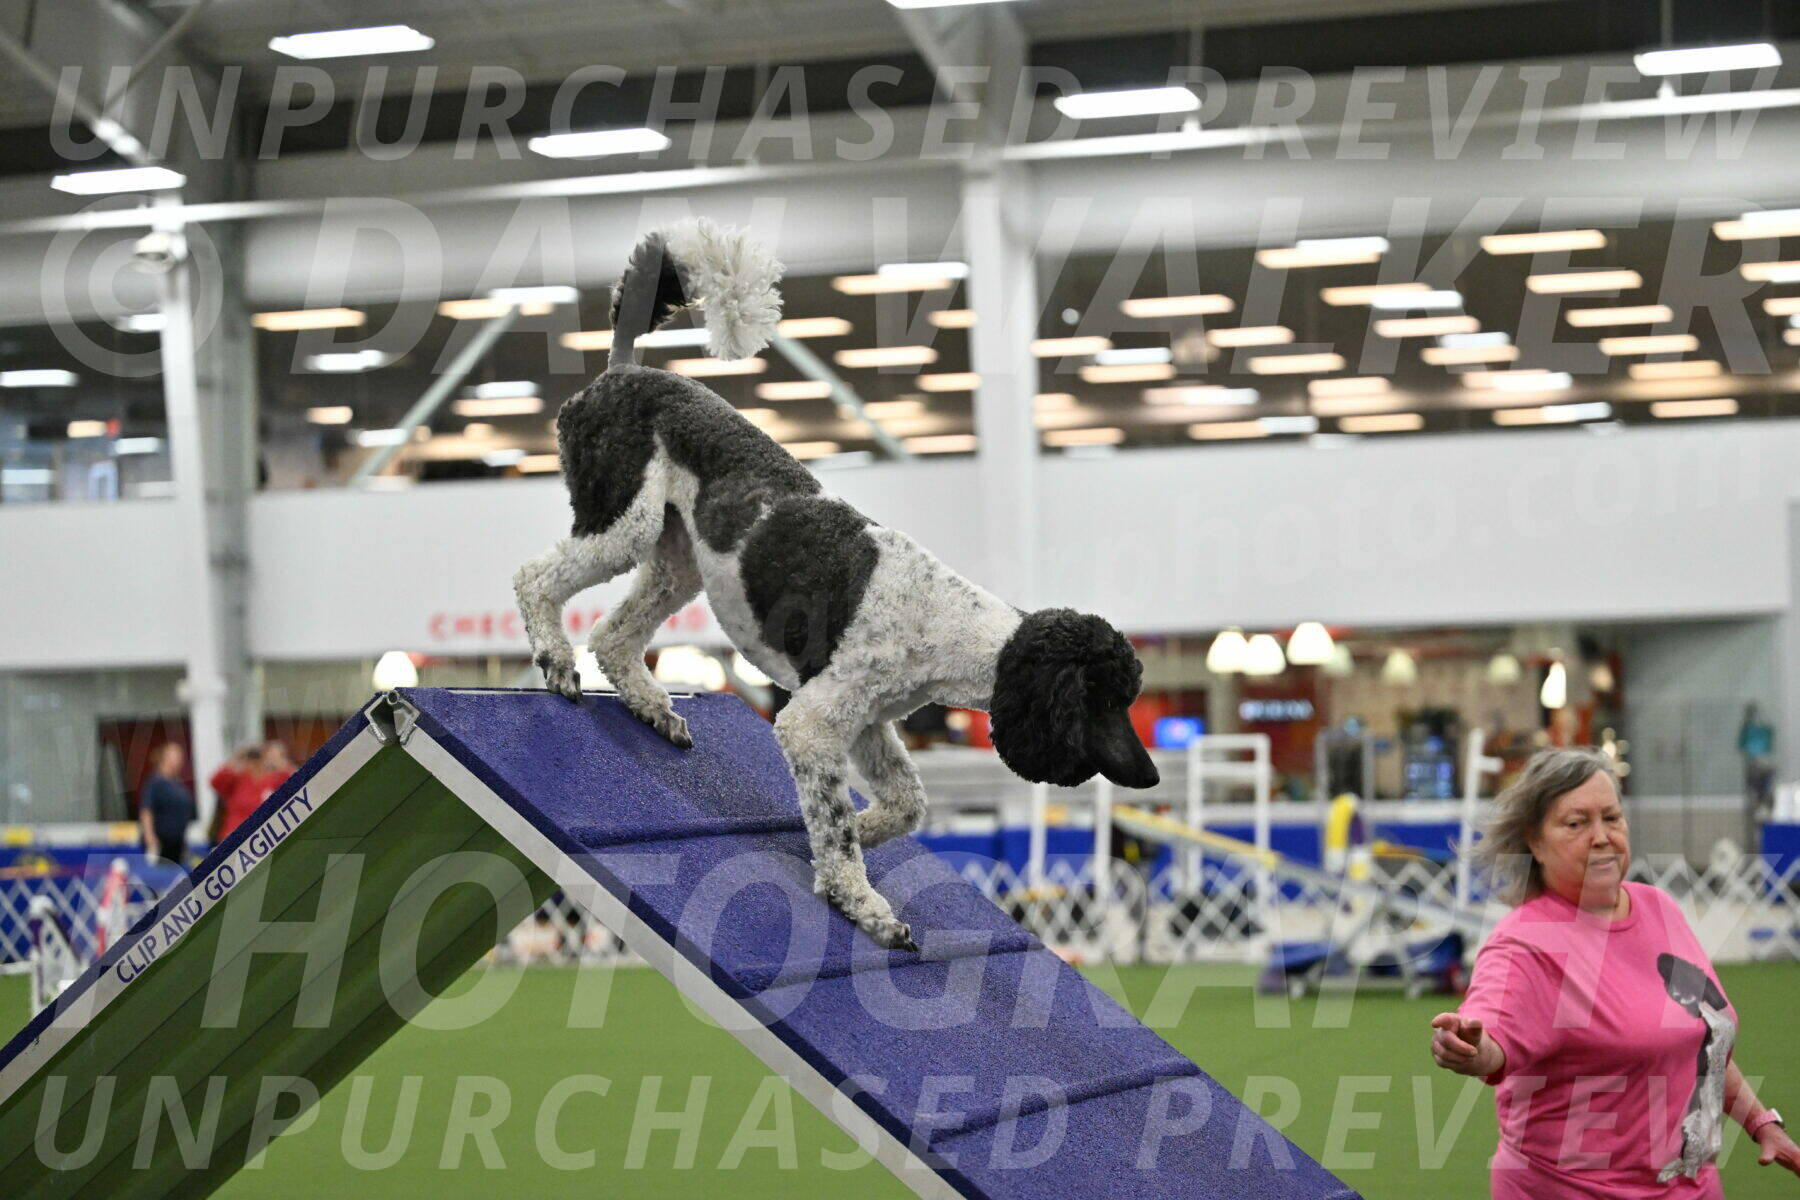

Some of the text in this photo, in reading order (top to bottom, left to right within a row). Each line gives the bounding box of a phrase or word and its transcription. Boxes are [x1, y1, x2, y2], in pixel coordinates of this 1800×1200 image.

[116, 787, 313, 984] CLIP AND GO AGILITY
